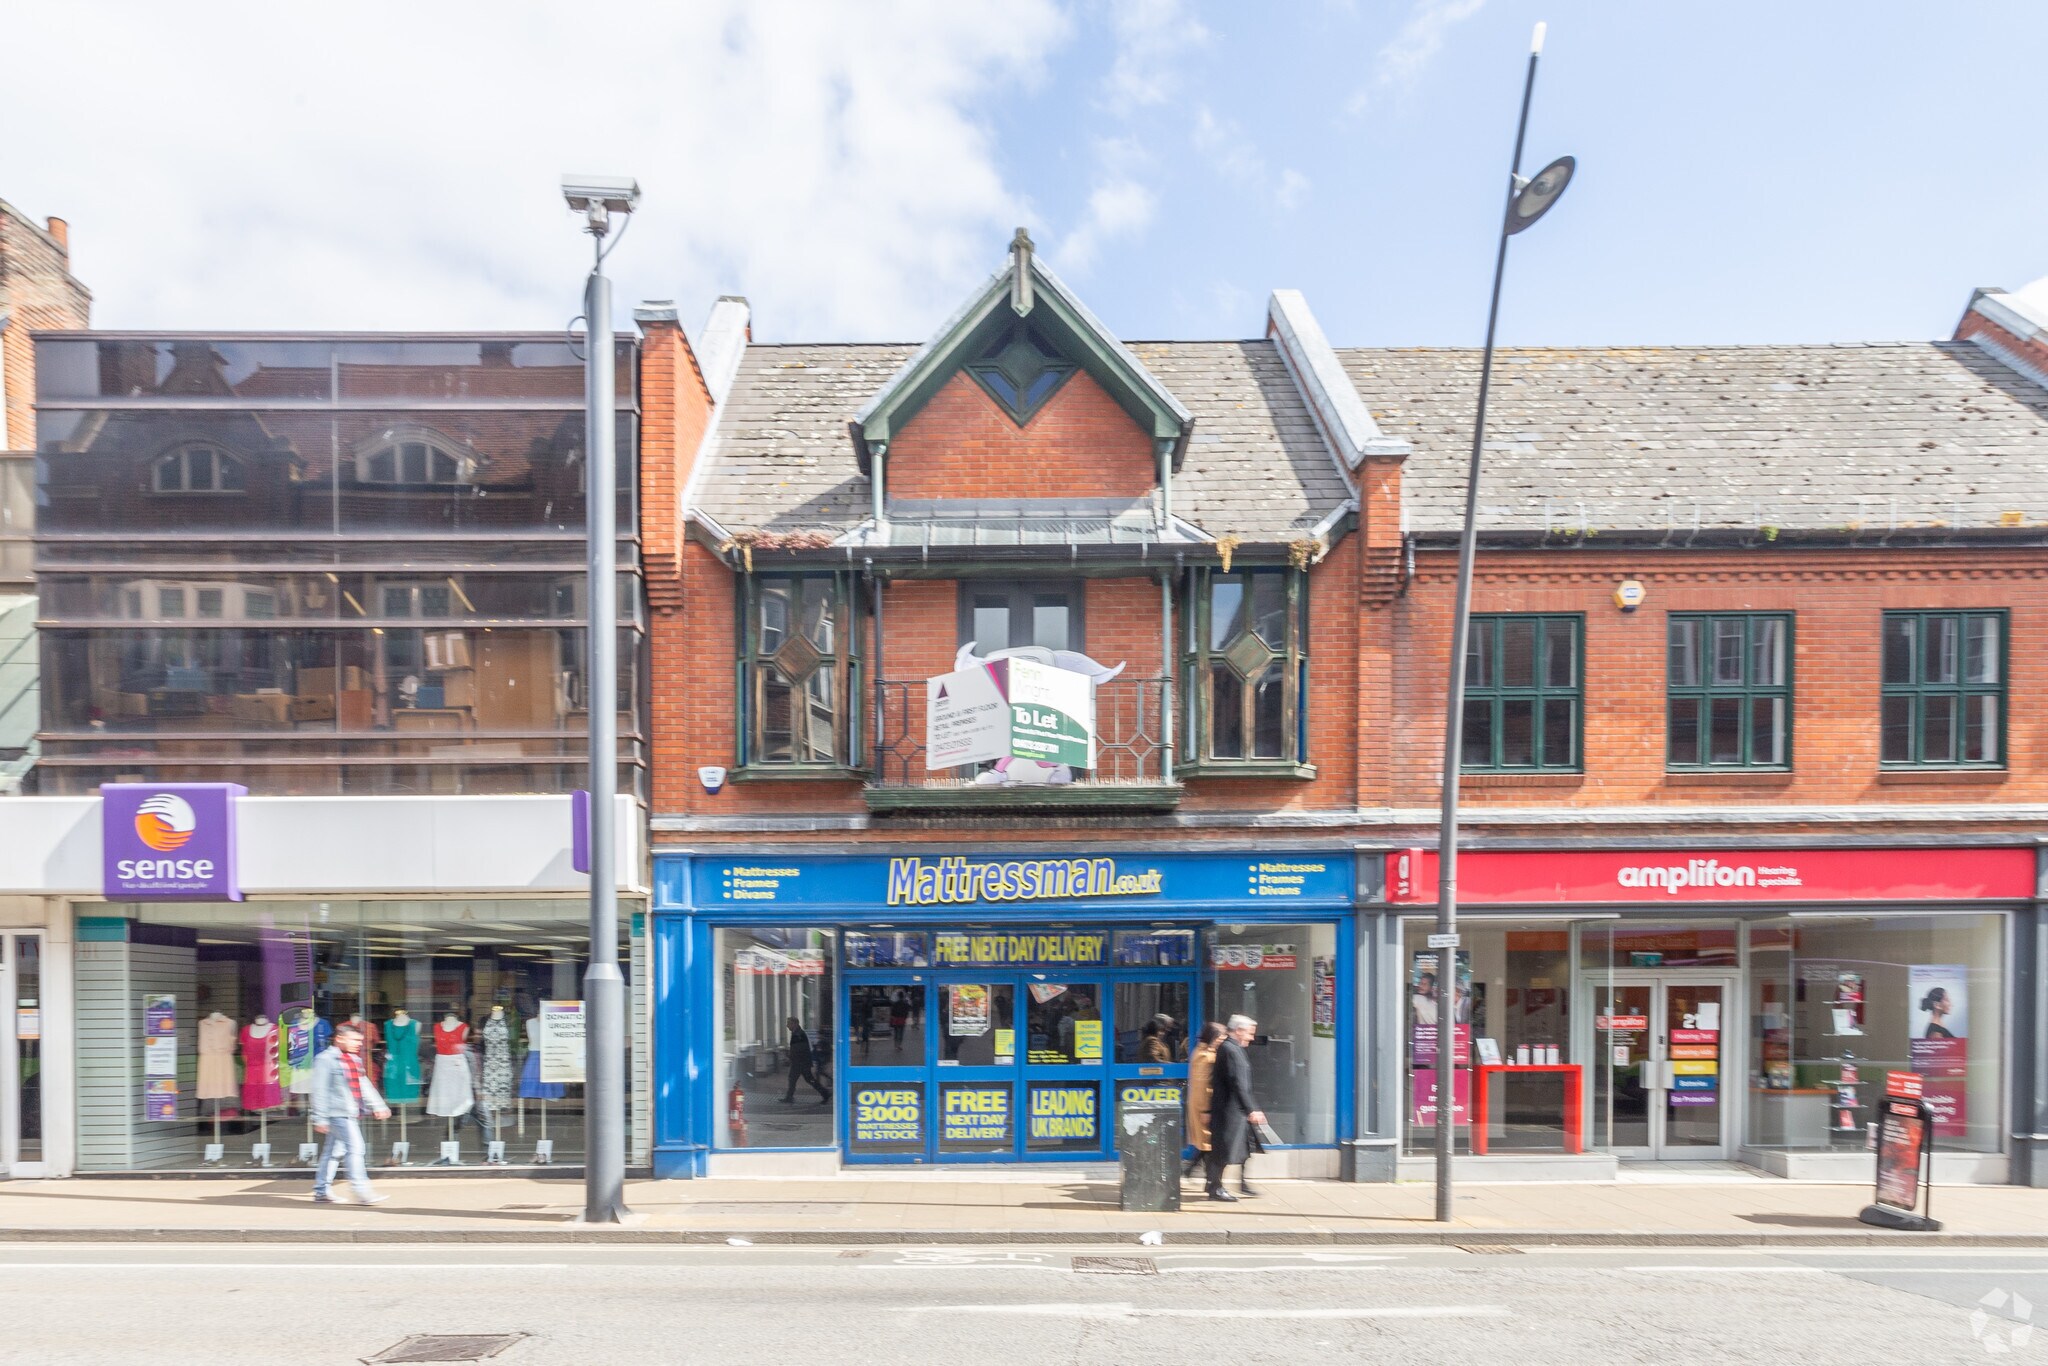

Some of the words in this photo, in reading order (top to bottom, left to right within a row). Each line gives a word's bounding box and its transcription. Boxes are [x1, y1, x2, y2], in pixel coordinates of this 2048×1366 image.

[1012, 706, 1031, 725] To
[1033, 710, 1059, 730] Let
[117, 859, 214, 880] sense
[733, 867, 800, 877] Mattresses
[1259, 863, 1326, 872] Mattresses
[733, 878, 779, 888] Frames
[1259, 874, 1305, 884] Frames
[1617, 859, 1756, 894] amplifon
[733, 890, 776, 899] Divans
[1259, 885, 1301, 895] Divans
[935, 936, 970, 962] FREE
[971, 937, 1007, 962] NEXT
[1008, 937, 1037, 962] DAY
[1038, 936, 1103, 962] DELIVERY
[857, 1091, 919, 1105] OVER
[945, 1091, 1008, 1112] FREE
[1122, 1088, 1181, 1102] OVER
[1032, 1090, 1095, 1115] LEADING
[857, 1106, 919, 1122] 3000
[945, 1114, 979, 1125] NEXT
[979, 1114, 1007, 1125] DAY
[945, 1127, 1007, 1138] DELIVERY
[1032, 1117, 1050, 1137] UK
[1050, 1117, 1095, 1137] BRANDS
[857, 1131, 873, 1139] IN
[874, 1131, 919, 1140] STOCK
